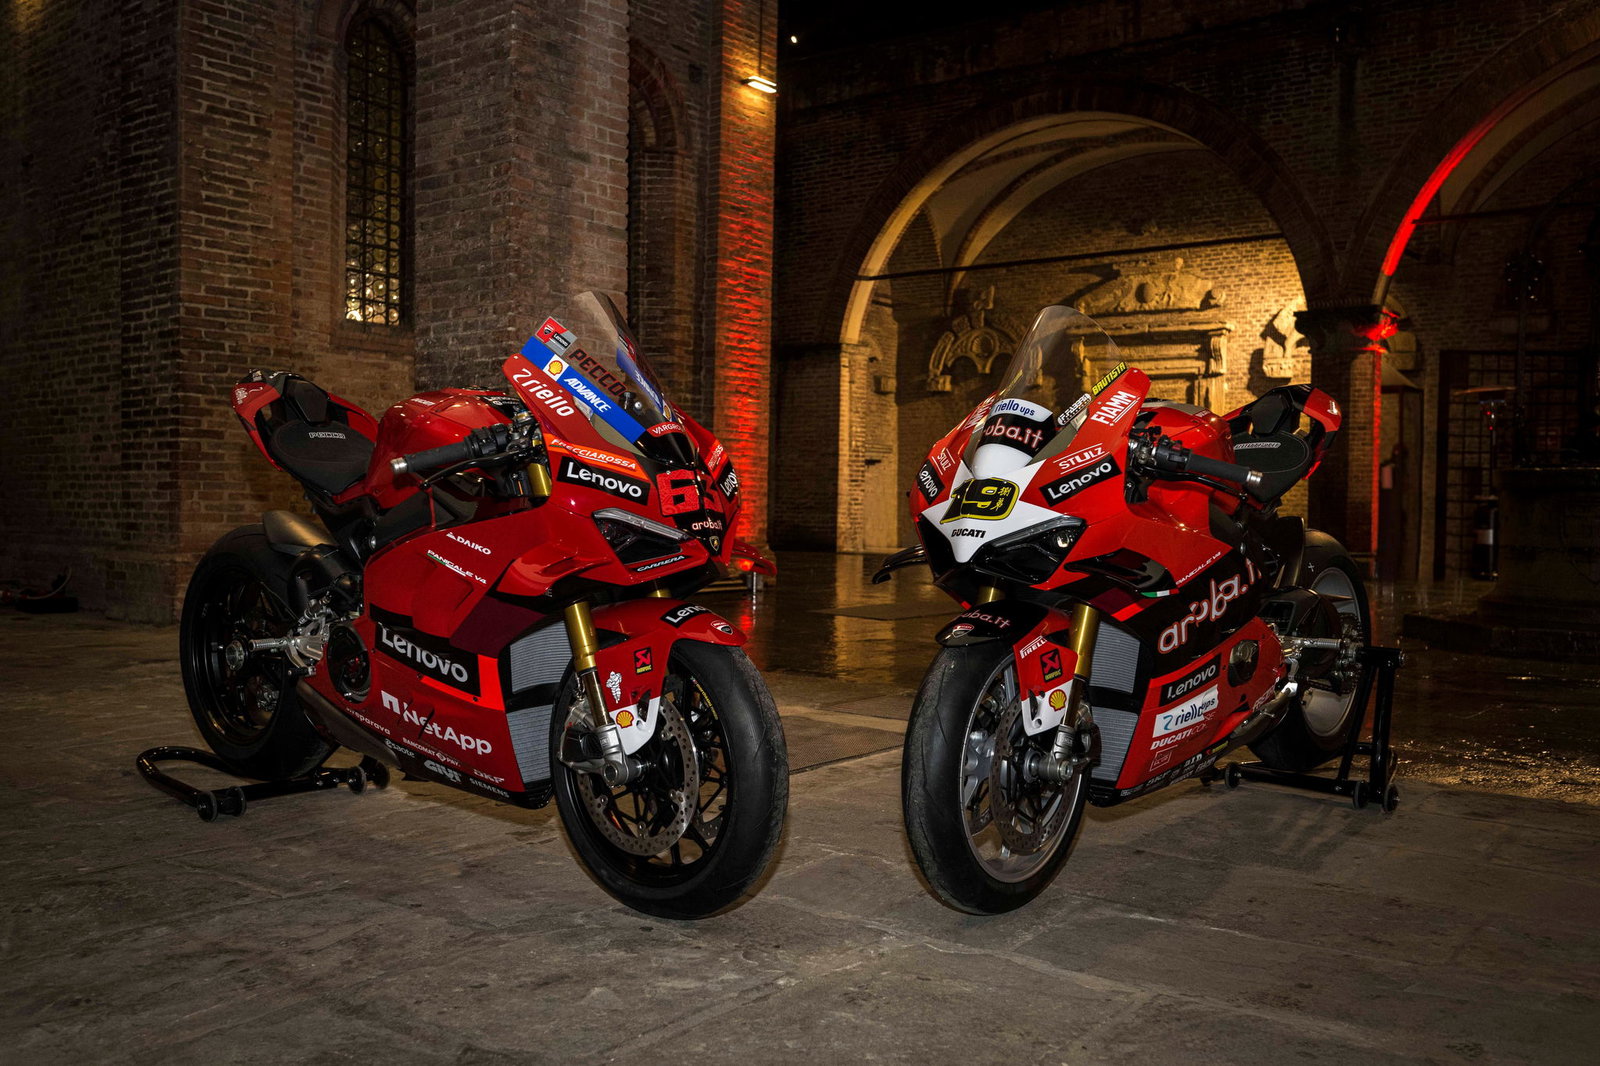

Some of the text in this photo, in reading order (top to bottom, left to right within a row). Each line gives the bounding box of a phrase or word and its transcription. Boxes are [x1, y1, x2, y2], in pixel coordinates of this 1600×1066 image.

[568, 348, 627, 397] PECCO
[1092, 362, 1126, 396] BAUTISTA
[563, 377, 611, 413] ADVANCE
[1090, 391, 1138, 425] FIAMM
[1019, 406, 1036, 417] ups
[983, 418, 1044, 449] uba.it
[550, 438, 637, 470] FRECCIAROSSA
[1058, 447, 1105, 470] STULZ
[566, 461, 642, 498] Lenovo
[1047, 462, 1112, 500] Lenovo
[456, 535, 491, 555] DAIKO
[951, 528, 986, 539] DUCATI
[427, 549, 474, 577] PANIGALE
[637, 555, 686, 573] CARRERA
[665, 605, 706, 623] Leno
[378, 622, 469, 683] Lenovo
[1167, 664, 1216, 699] Lenovo
[402, 702, 493, 756] NetApp
[1175, 703, 1204, 726] riello
[1150, 728, 1192, 751] DUCATI
